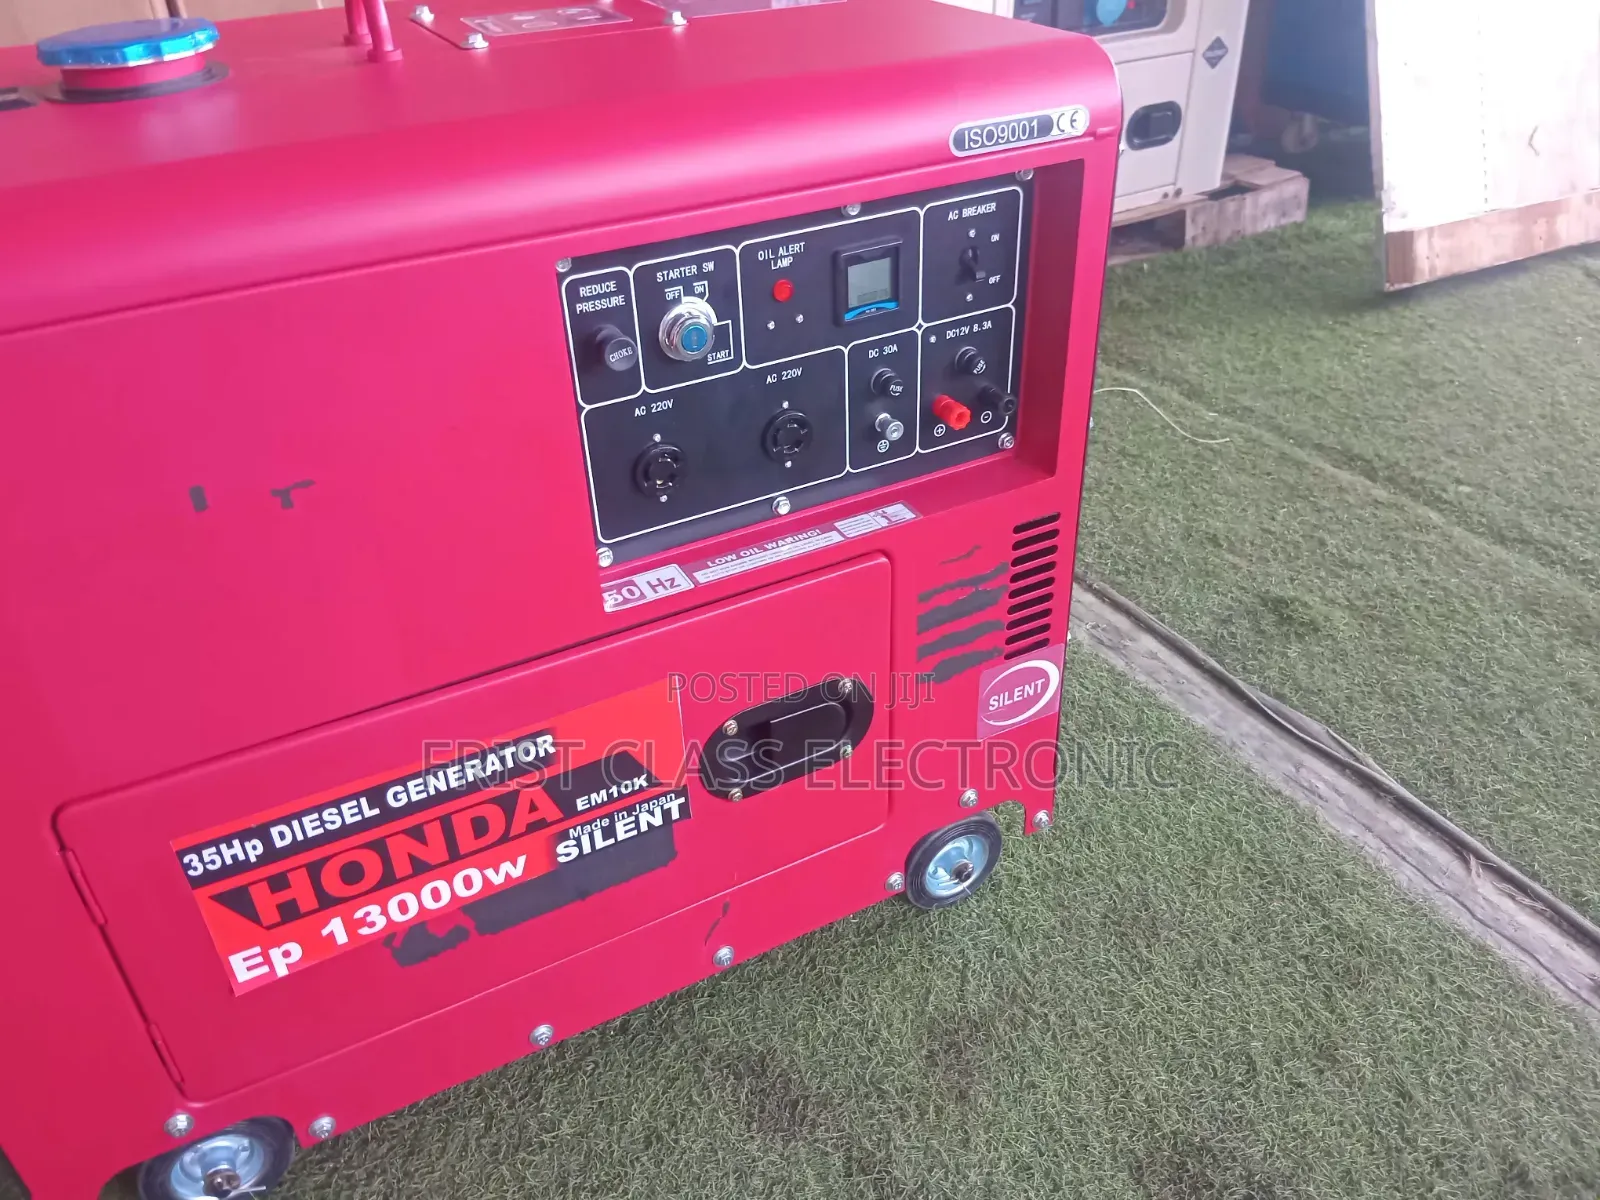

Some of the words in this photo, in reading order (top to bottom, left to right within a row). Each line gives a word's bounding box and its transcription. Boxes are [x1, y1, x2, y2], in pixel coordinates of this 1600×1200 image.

[964, 119, 1038, 149] ISO9001
[948, 210, 959, 221] AC
[962, 202, 996, 218] BREAKER
[991, 233, 999, 242] ON
[758, 250, 775, 261] OIL
[778, 242, 805, 256] ALERT
[656, 265, 698, 282] STARTER
[702, 261, 715, 273] SW
[771, 256, 793, 270] LAMP
[989, 275, 1000, 285] OFF
[579, 281, 617, 298] REDUCE
[665, 290, 680, 301] OFF
[694, 285, 704, 294] ON
[576, 295, 626, 314] PRESSURE
[946, 325, 970, 339] DC12V
[973, 320, 992, 333] 8.3A
[609, 346, 633, 363] CHOKE
[707, 350, 730, 362] START
[869, 349, 879, 359] DC
[883, 344, 898, 355] 30A
[973, 359, 986, 374] FUSE
[766, 374, 778, 385] AC
[782, 367, 803, 381] 220V
[889, 384, 904, 393] FUSE
[634, 406, 647, 417] AC
[651, 399, 674, 413] 220V
[707, 554, 737, 568] LOW
[740, 547, 763, 558] OIL
[764, 529, 822, 550] WARING!
[602, 585, 641, 604] 50
[646, 578, 682, 594] Hz
[988, 678, 1045, 711] SILENT
[182, 836, 264, 877] 35Hp
[270, 797, 380, 848] DIESEL
[386, 734, 556, 808] GENERATOR
[569, 817, 610, 838] Made
[614, 809, 628, 822] in
[632, 793, 675, 816] Japan
[248, 786, 564, 927] HONDA
[576, 774, 649, 812] EM10K
[228, 941, 303, 983] Ep
[321, 854, 527, 946] 13000w
[556, 797, 686, 863] SILENT
